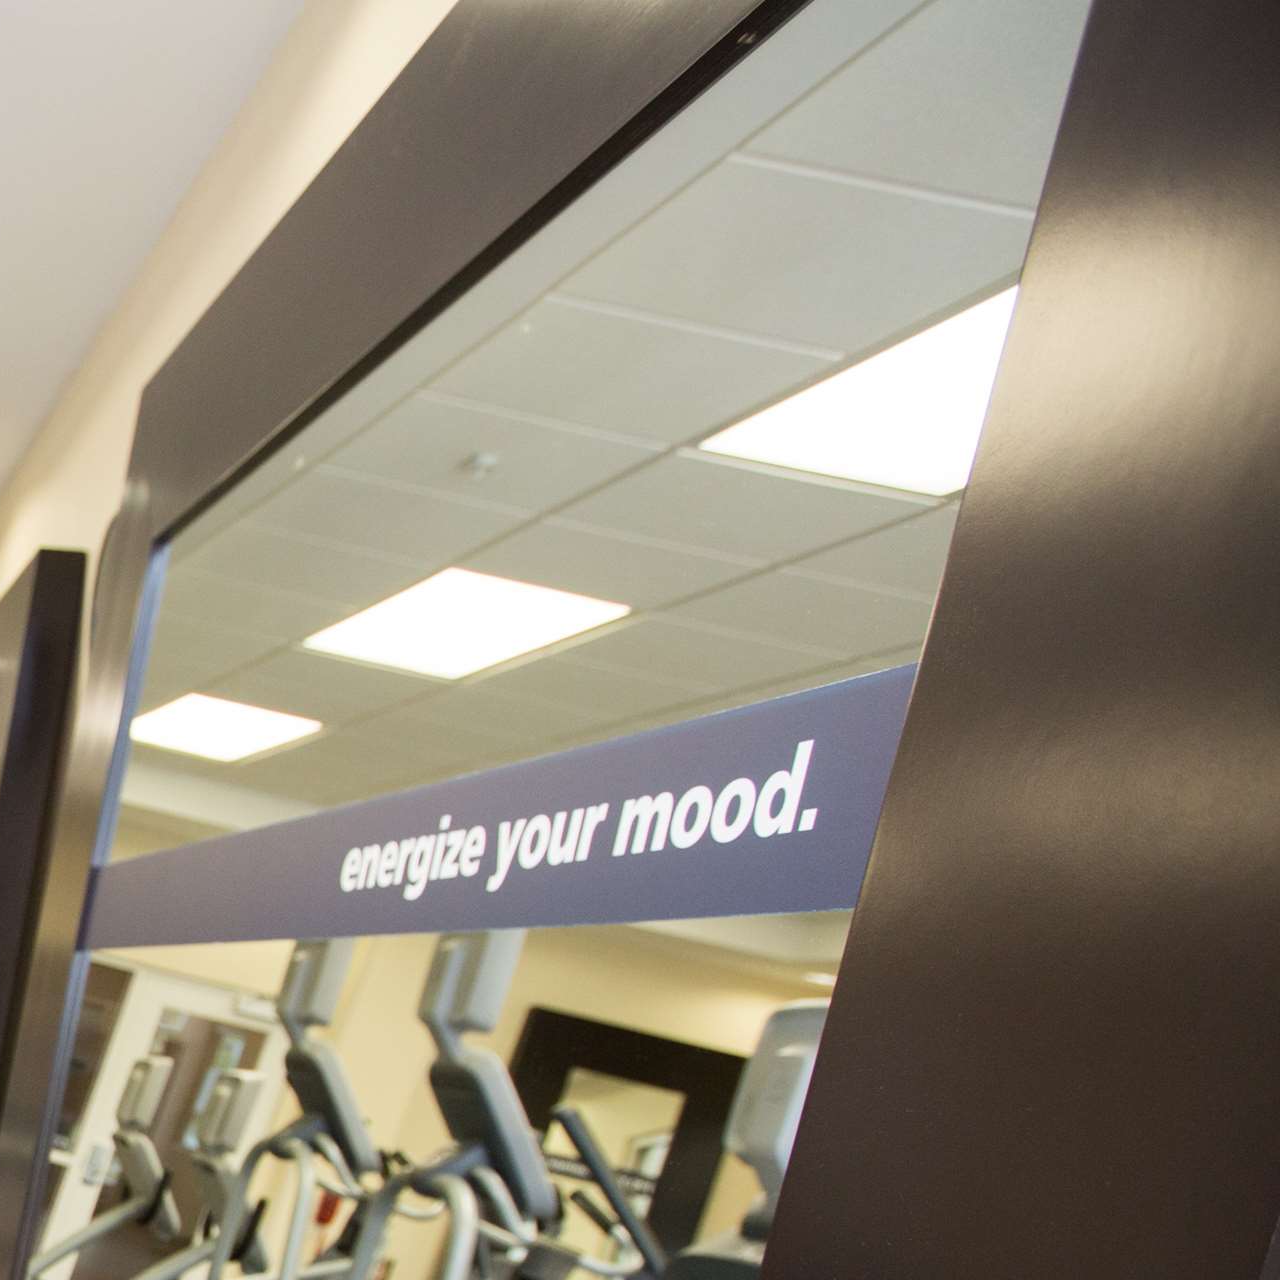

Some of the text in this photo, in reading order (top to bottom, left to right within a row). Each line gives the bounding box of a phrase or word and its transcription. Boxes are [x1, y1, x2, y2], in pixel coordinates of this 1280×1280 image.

[340, 739, 818, 900] energize your mood.
